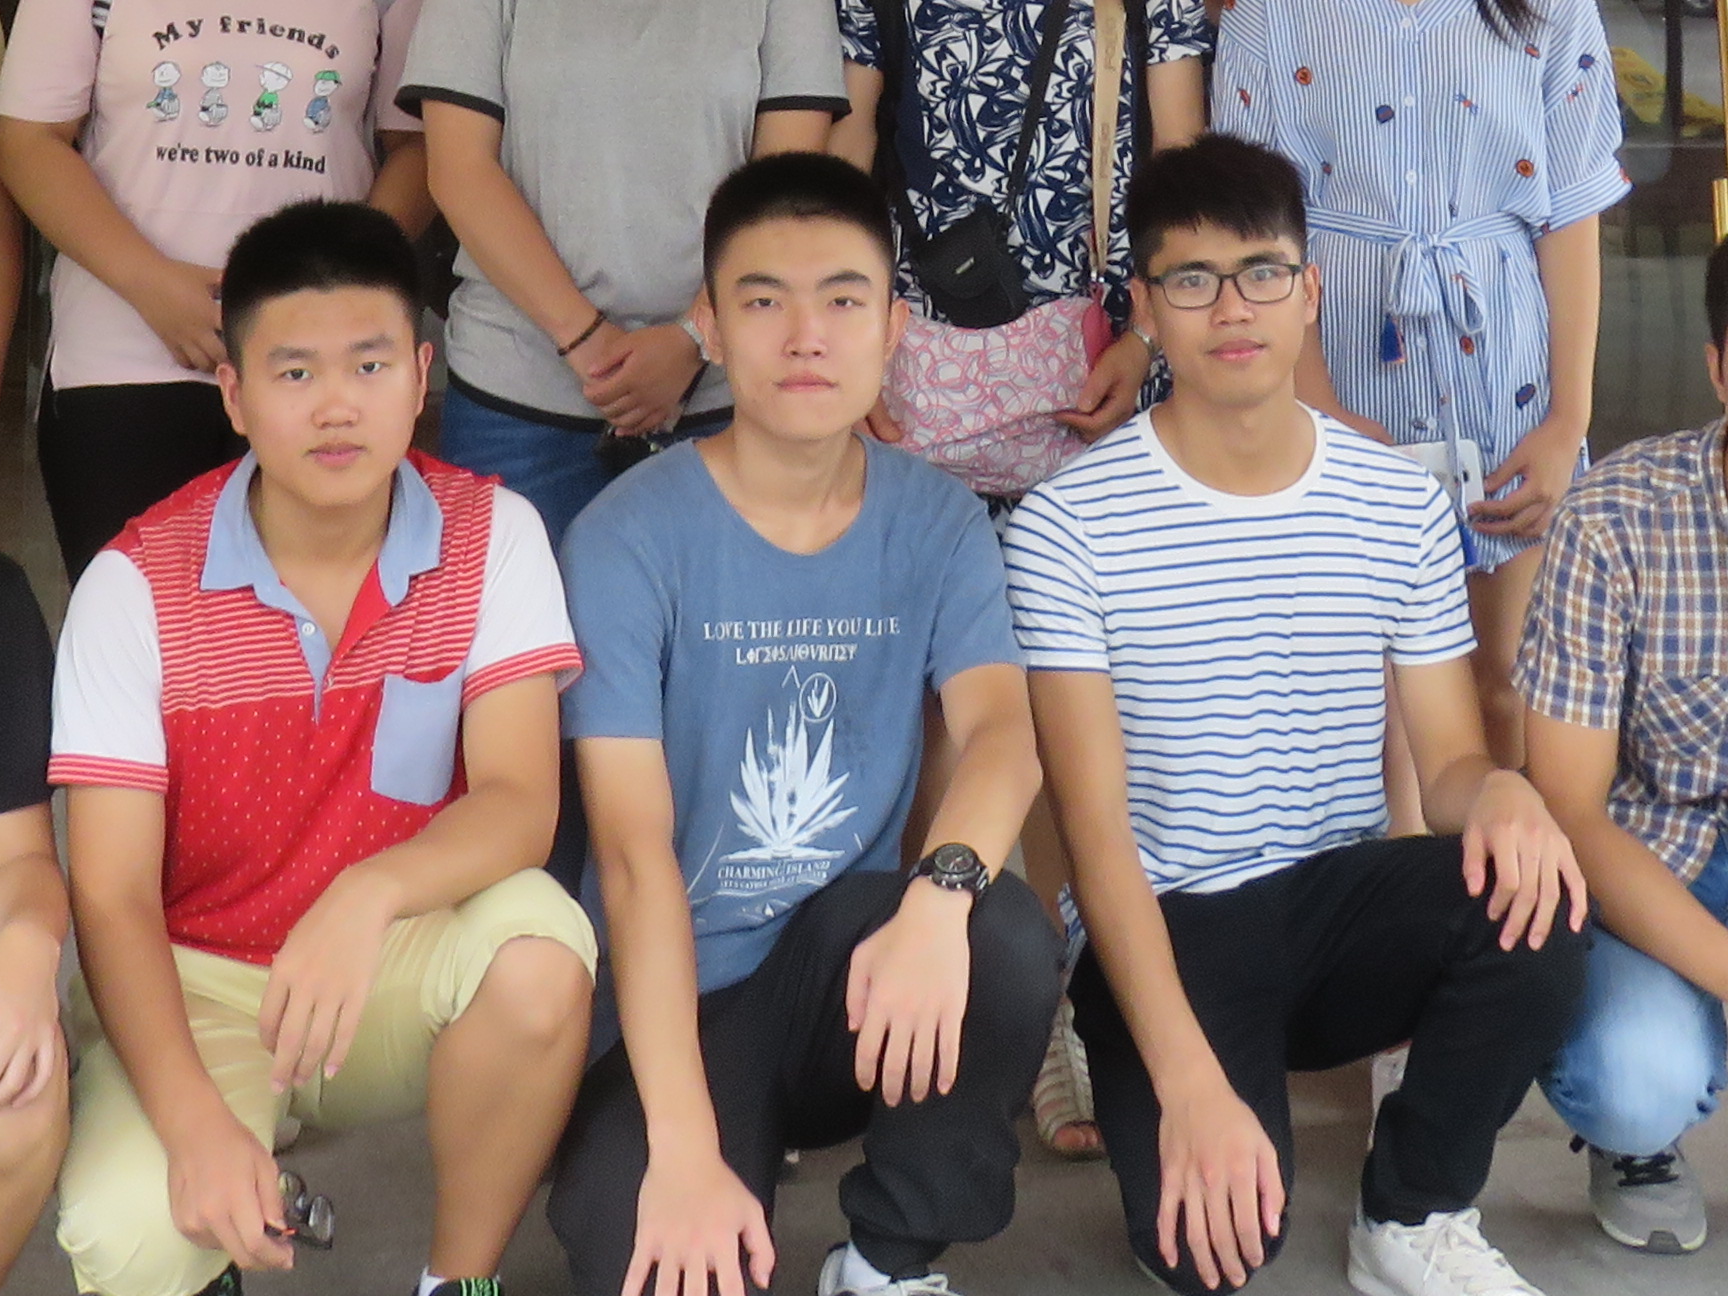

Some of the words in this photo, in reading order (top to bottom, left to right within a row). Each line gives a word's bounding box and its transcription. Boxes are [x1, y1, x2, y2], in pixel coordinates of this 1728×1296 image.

[152, 18, 204, 51] My
[220, 16, 340, 60] friends
[156, 143, 199, 163] we're
[205, 146, 240, 165] two
[245, 147, 267, 167] of
[267, 153, 278, 169] a
[283, 150, 327, 174] kind
[703, 620, 744, 641] LOVE
[747, 619, 783, 640] THE
[787, 617, 823, 638] LIFE
[826, 616, 862, 637] YOU
